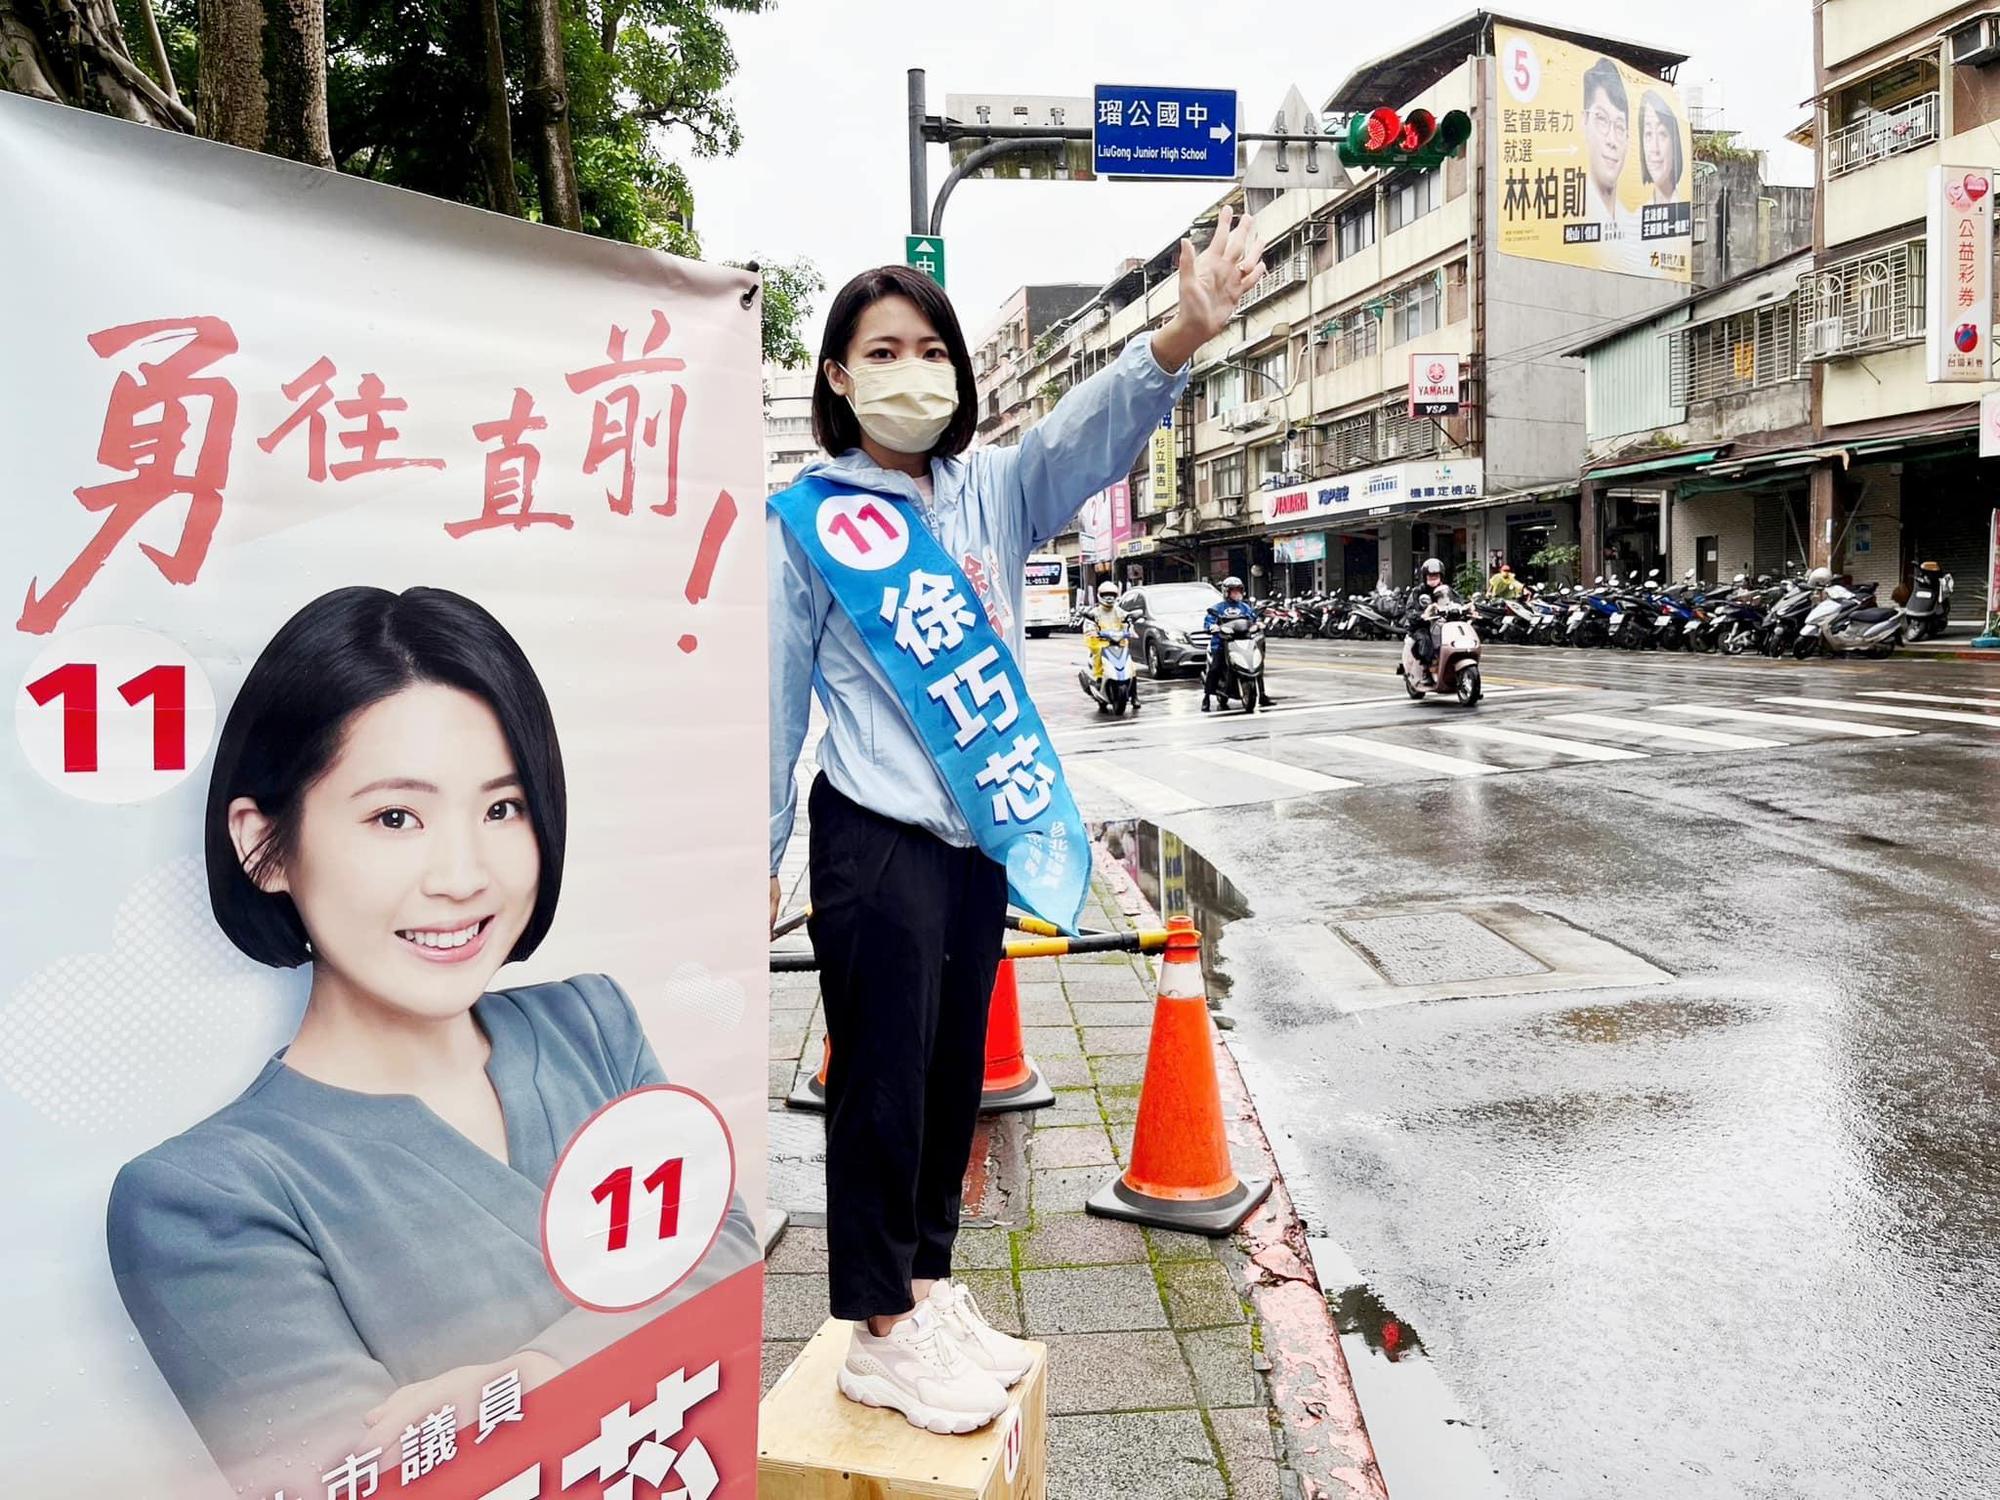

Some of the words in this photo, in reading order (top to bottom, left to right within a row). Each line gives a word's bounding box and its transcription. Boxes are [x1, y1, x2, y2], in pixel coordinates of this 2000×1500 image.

[1514, 49, 1530, 91] 5
[1098, 99, 1208, 128] 瑠公國中
[1503, 109, 1574, 133] 監督最有力
[1098, 144, 1132, 161] LiuGong
[1133, 146, 1159, 159] Junior
[1160, 147, 1179, 162] High
[1180, 147, 1207, 160] School
[1503, 138, 1533, 163] 就選
[1503, 167, 1587, 221] 林柏勛
[915, 255, 936, 276] 中
[1958, 218, 1975, 308] 公益彩券
[1418, 386, 1455, 396] YAMAHA
[1425, 404, 1448, 414] YSP
[828, 502, 900, 556] 11
[25, 662, 186, 773] 11
[879, 567, 1056, 825] 徐巧芯
[590, 1156, 684, 1252] 11
[262, 1367, 524, 1500] 市議員
[1007, 1416, 1019, 1473] 11
